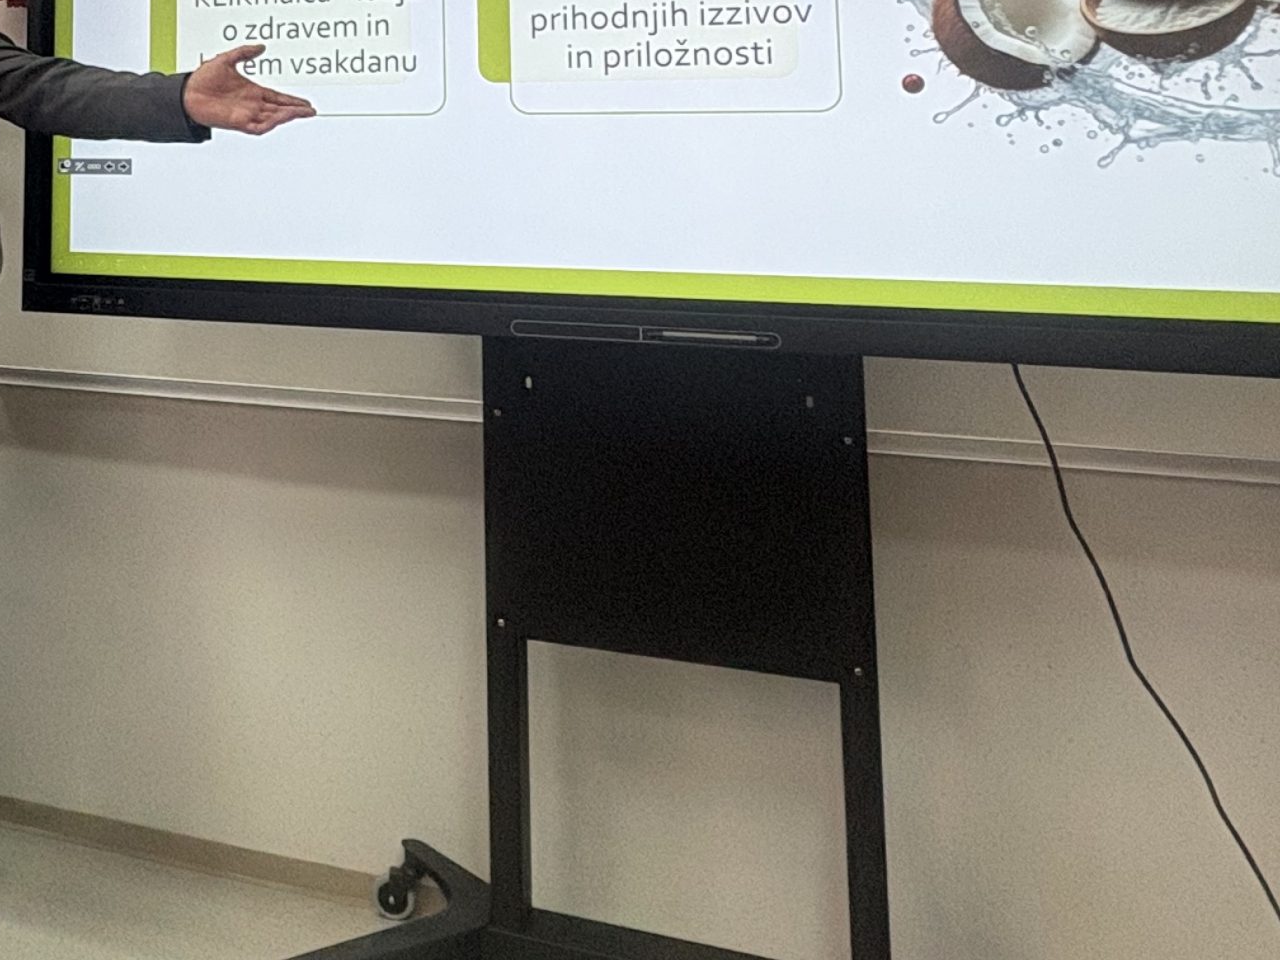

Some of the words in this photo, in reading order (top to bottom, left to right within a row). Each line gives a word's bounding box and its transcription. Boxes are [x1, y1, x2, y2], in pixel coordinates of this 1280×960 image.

[222, 23, 238, 41] o
[245, 16, 358, 41] zdravem
[367, 14, 390, 37] in
[530, 1, 689, 39] prihodnjih
[700, 0, 813, 26] izzivov
[290, 48, 418, 76] vsakdanu
[567, 43, 593, 69] in
[604, 38, 773, 76] priložnosti
